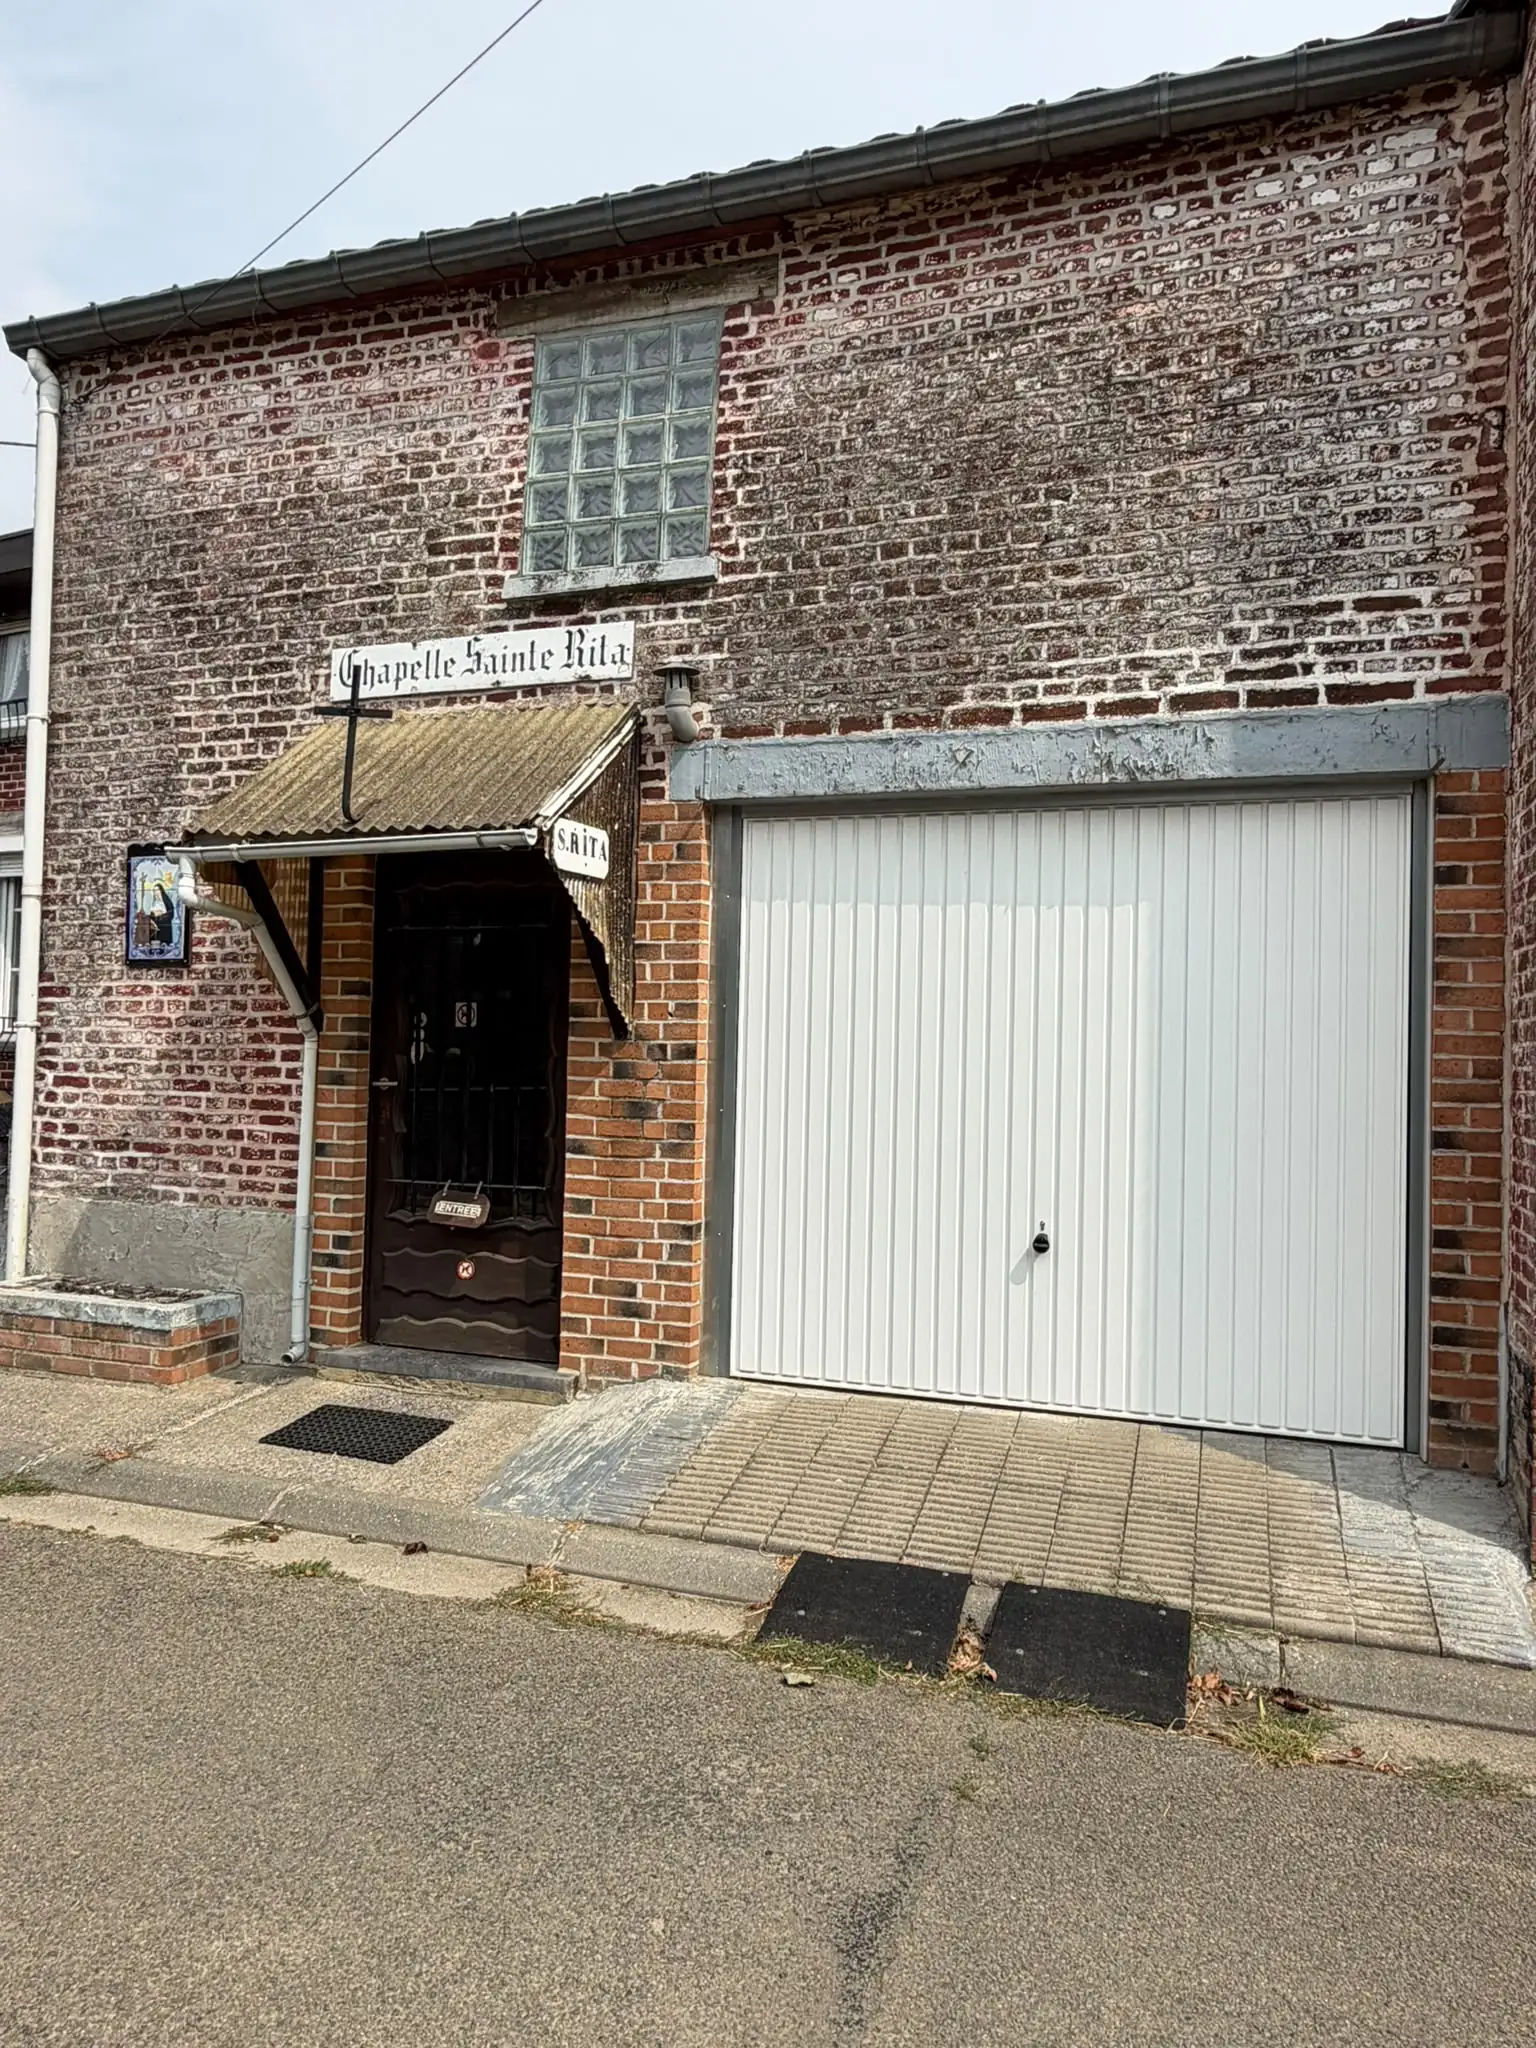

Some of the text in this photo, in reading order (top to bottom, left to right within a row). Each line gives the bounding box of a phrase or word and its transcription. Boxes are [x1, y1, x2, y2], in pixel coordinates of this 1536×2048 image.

[339, 628, 629, 693] Chapelle Sainte Rita
